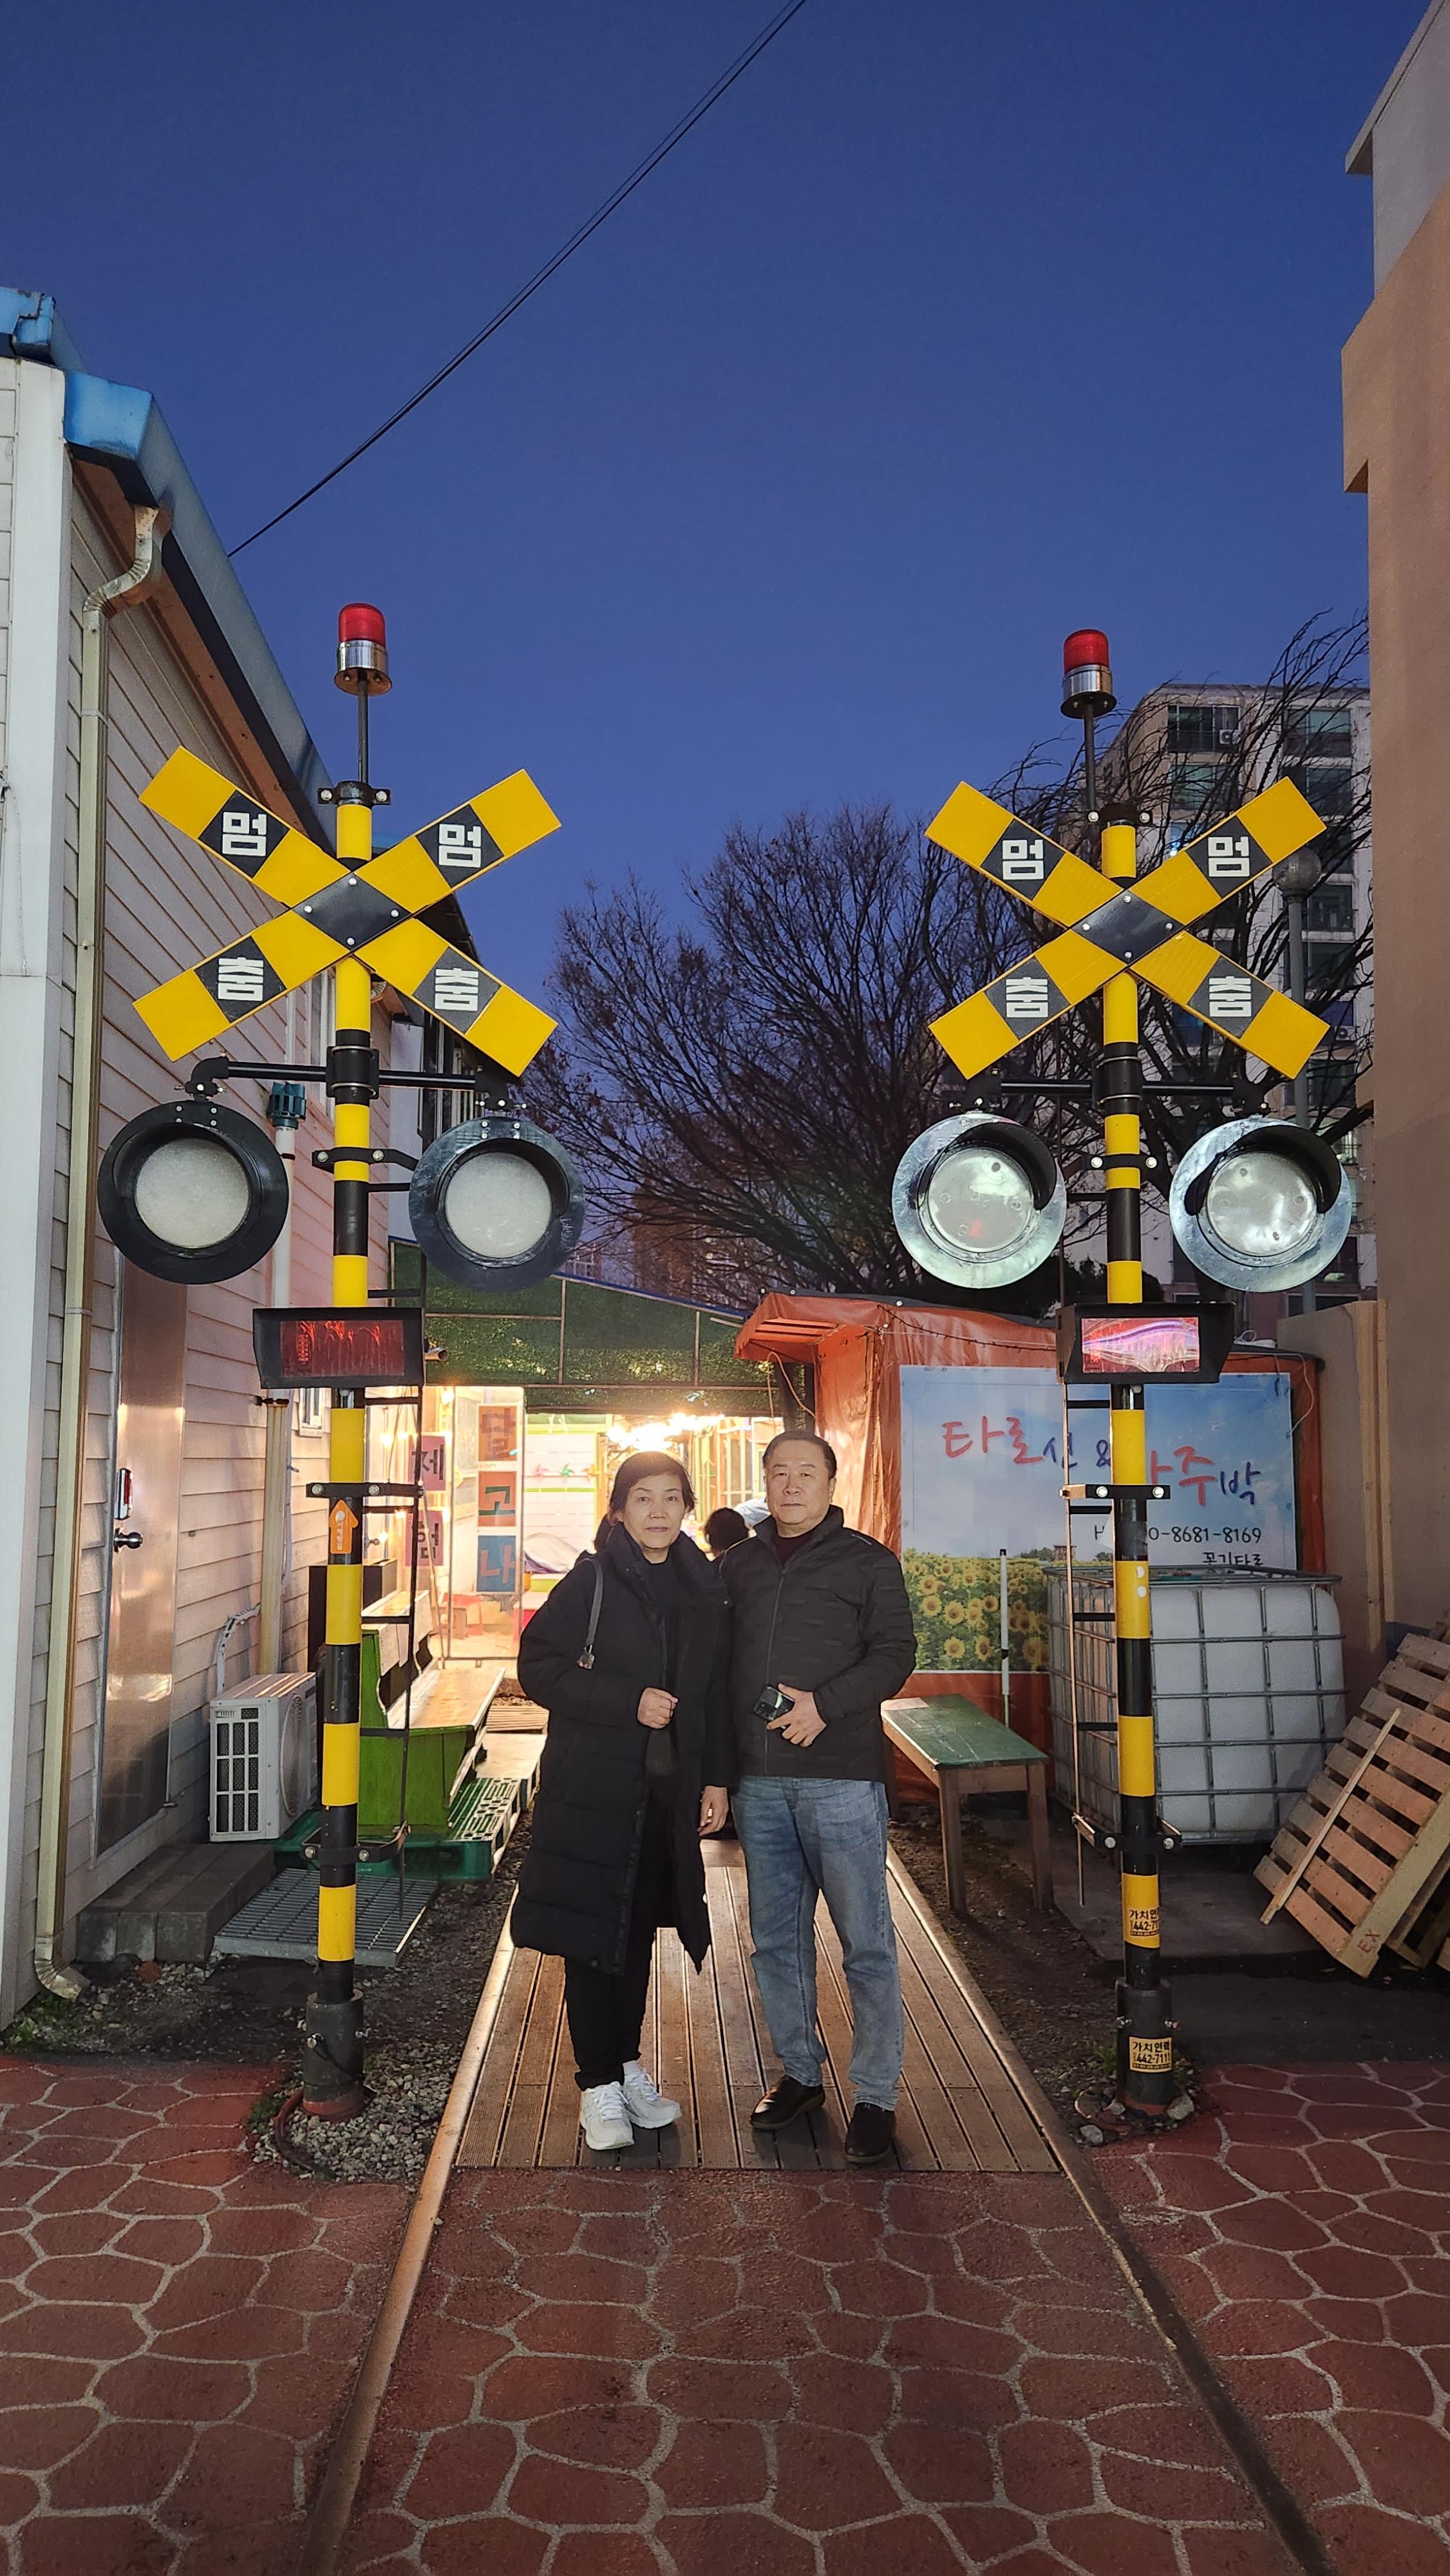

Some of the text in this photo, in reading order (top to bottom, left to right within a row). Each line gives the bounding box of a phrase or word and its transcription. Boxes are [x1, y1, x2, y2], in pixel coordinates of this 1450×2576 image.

[223, 812, 267, 857] 멈
[438, 824, 482, 868] 멈
[1003, 838, 1044, 880] 멈
[1208, 836, 1250, 877] 멈
[218, 957, 264, 1001] 춤
[434, 968, 479, 1012] 춤
[1006, 977, 1048, 1019] 춤
[1209, 976, 1252, 1018] 춤
[1148, 1527, 1261, 1543] 0-8681-8169
[1129, 1908, 1159, 1920] 가치인
